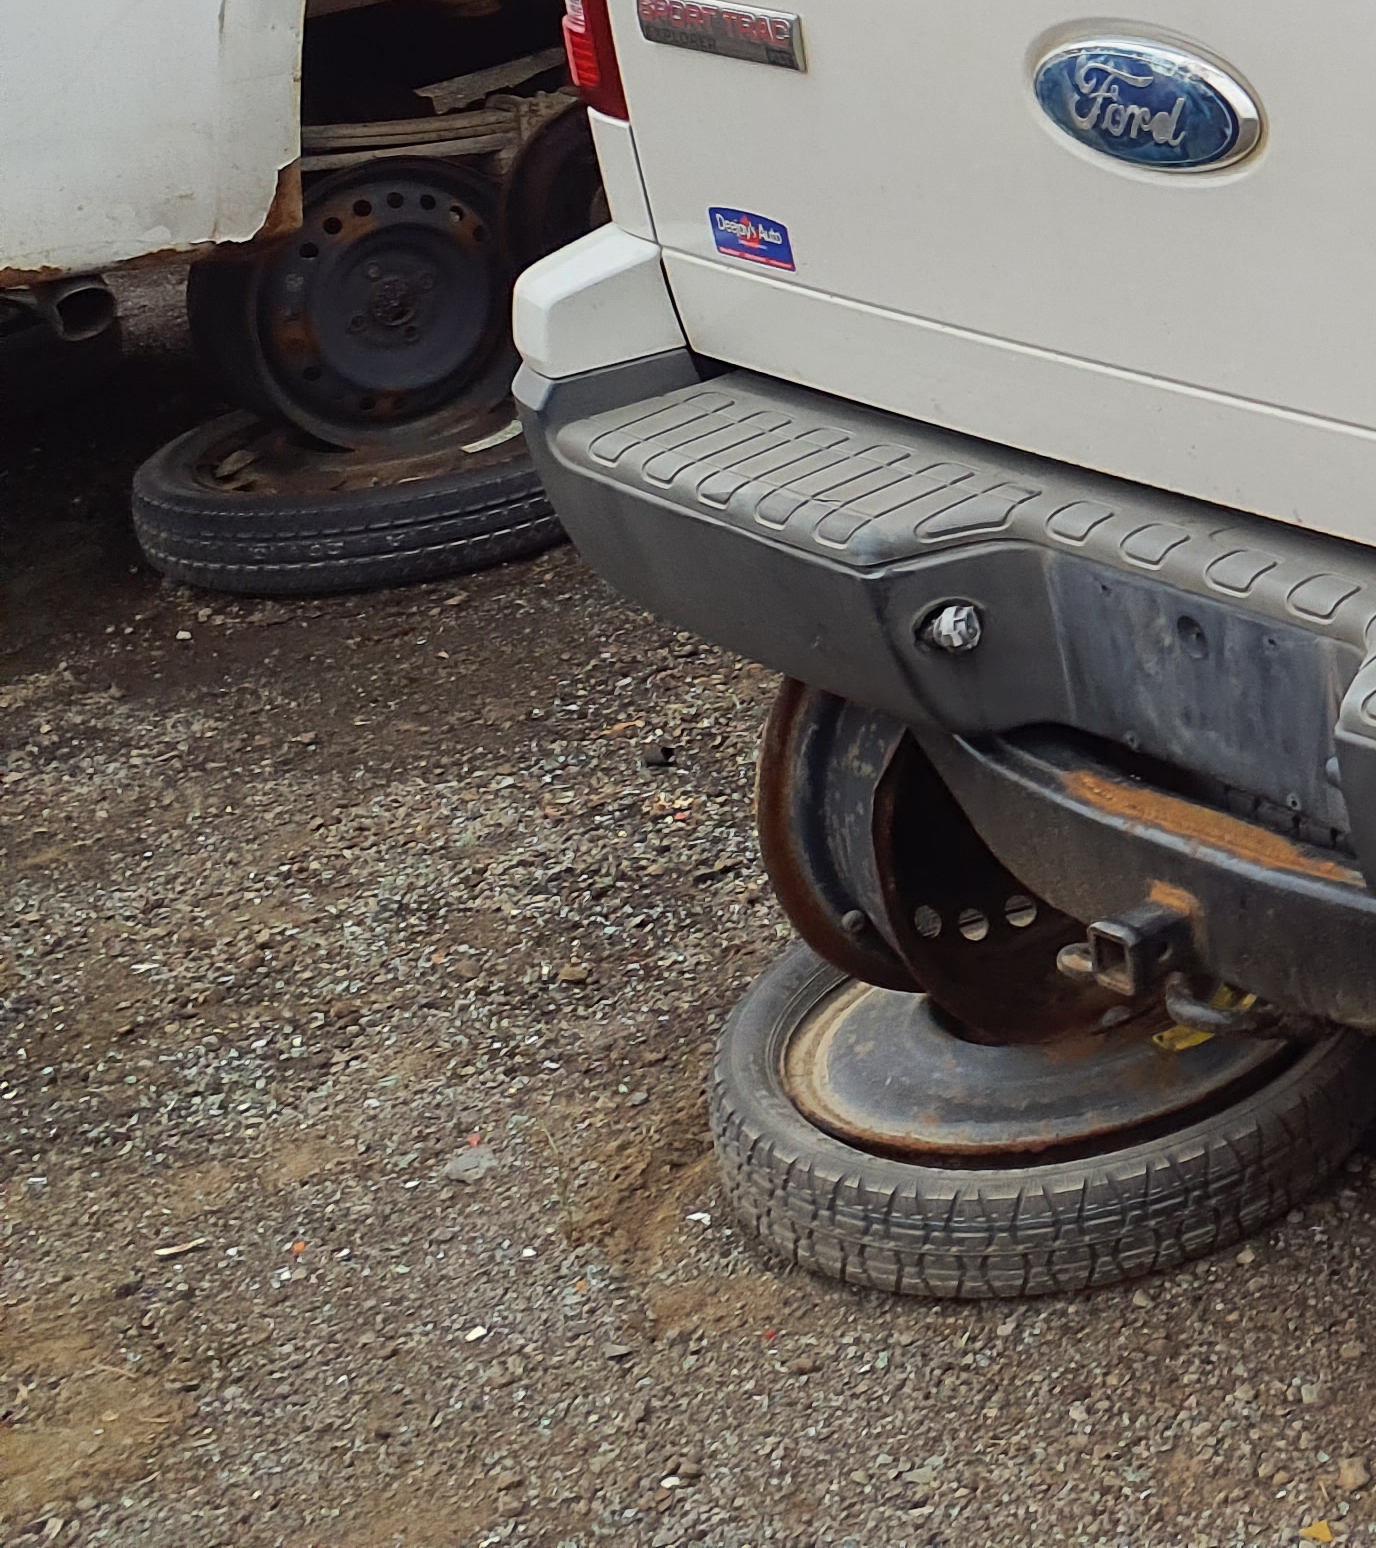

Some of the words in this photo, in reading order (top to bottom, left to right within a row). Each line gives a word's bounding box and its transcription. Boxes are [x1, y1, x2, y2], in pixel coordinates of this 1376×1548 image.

[721, 8, 792, 48] TRAC
[1069, 62, 1188, 148] Ford
[758, 223, 783, 245] Auto
